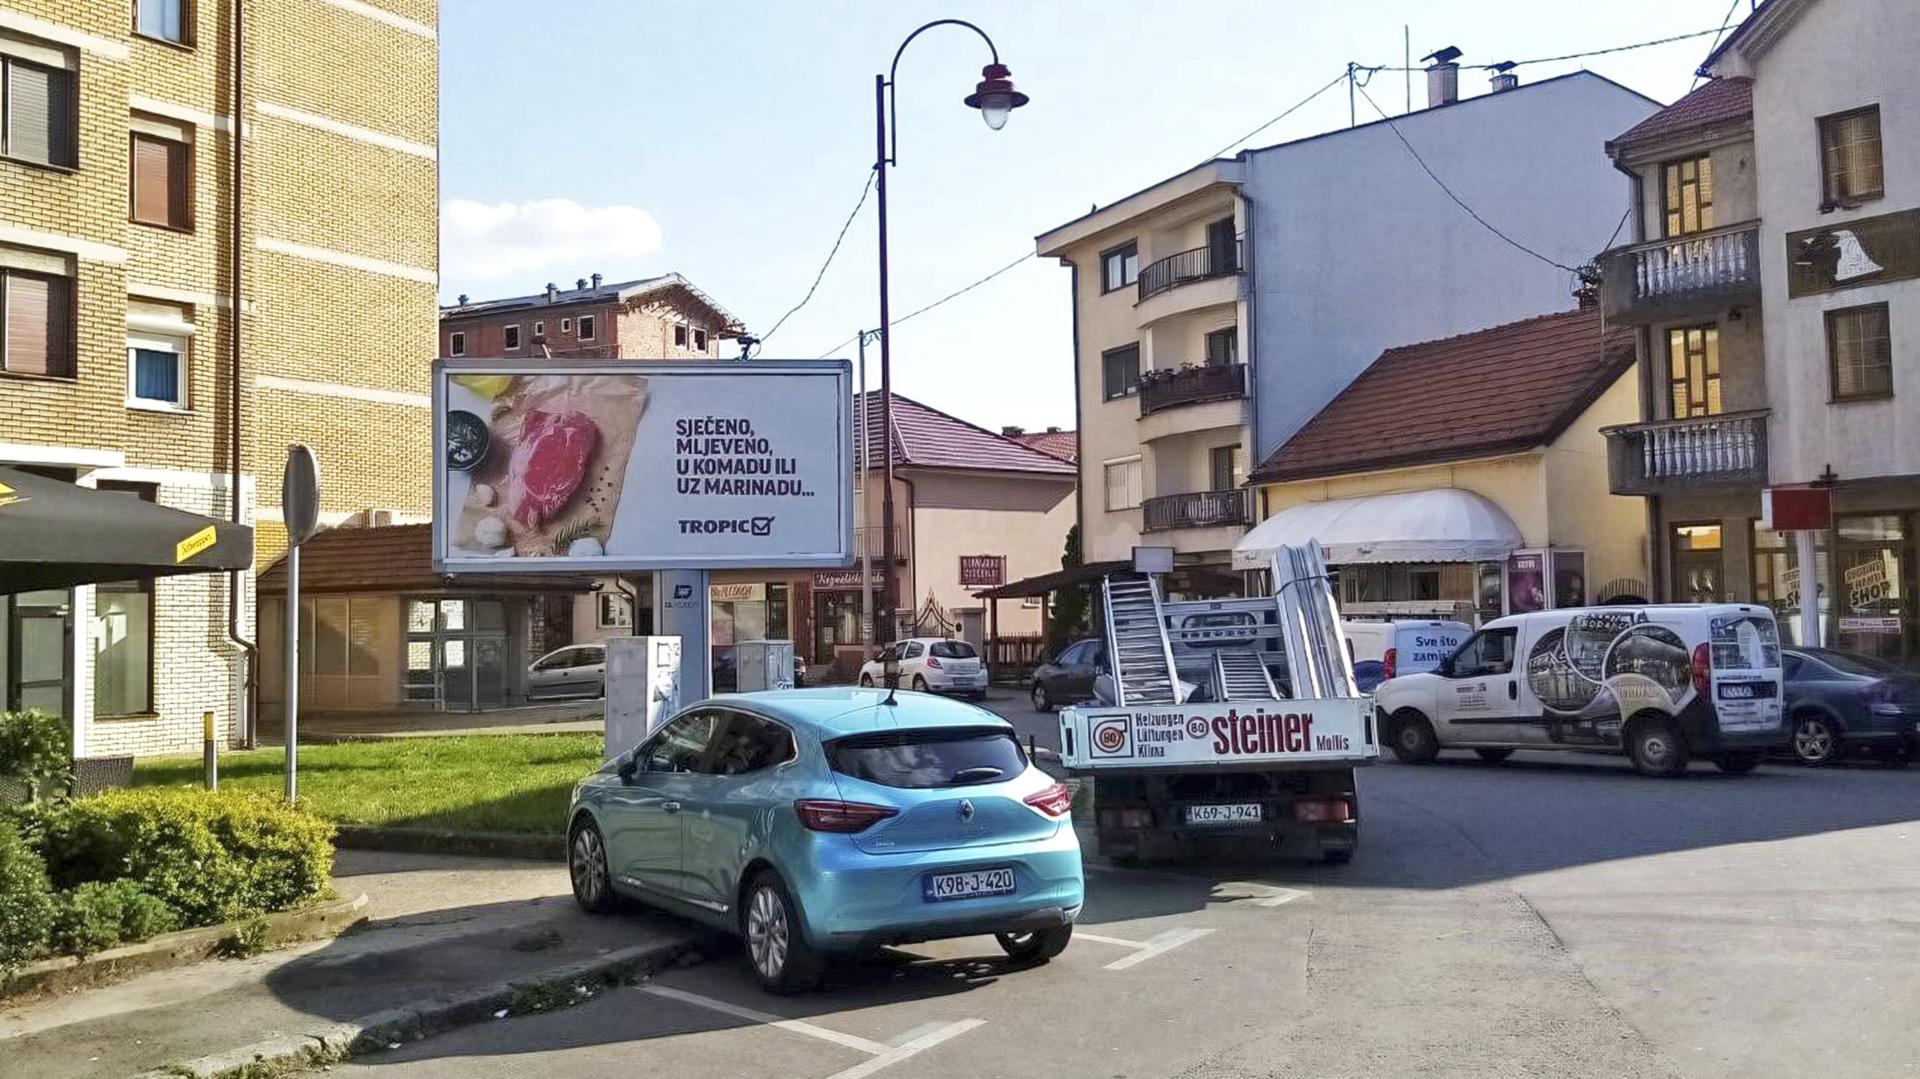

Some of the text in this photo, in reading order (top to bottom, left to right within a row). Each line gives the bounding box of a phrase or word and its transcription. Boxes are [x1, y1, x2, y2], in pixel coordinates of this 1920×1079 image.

[676, 416, 755, 438] SJEČENO,
[676, 438, 773, 457] MLJEVENO,
[676, 458, 797, 475] U KOMADU ILI
[677, 478, 815, 497] UZ MARINADU...
[678, 519, 750, 534] TROPIC
[1851, 580, 1890, 607] SHOP
[1415, 636, 1438, 647] Sve
[1211, 708, 1313, 755] steiner
[1138, 744, 1165, 758] Klima
